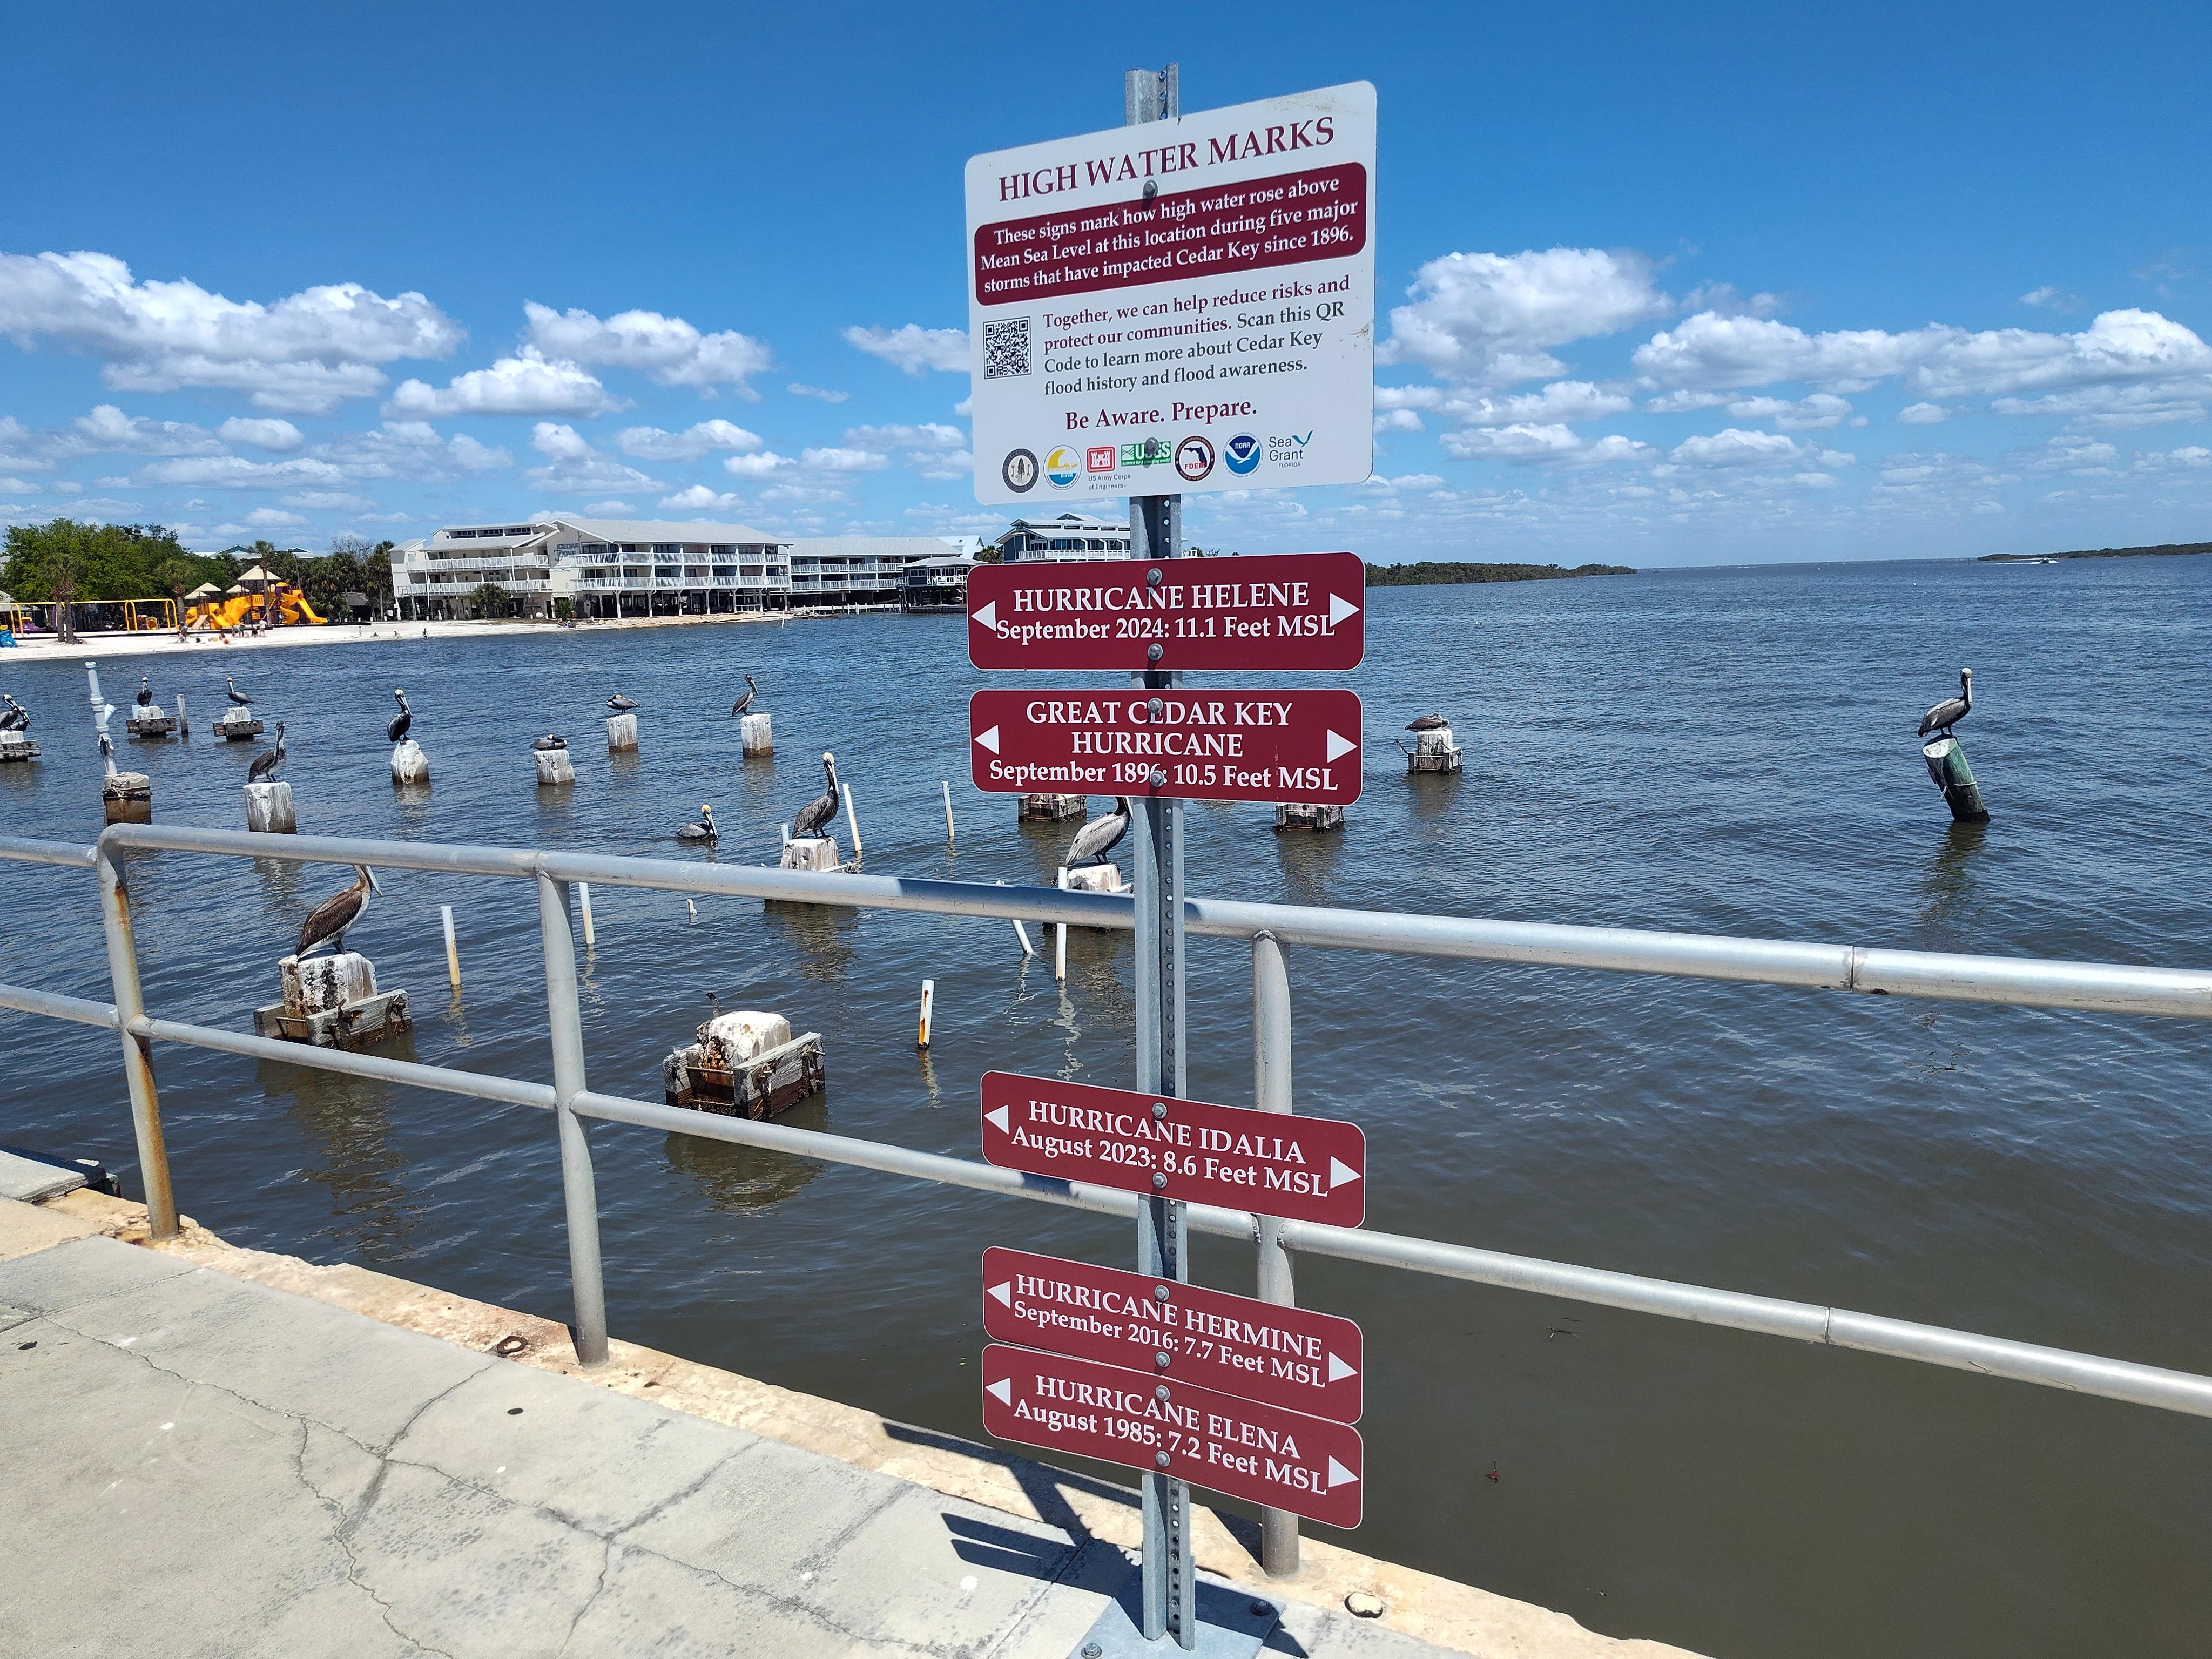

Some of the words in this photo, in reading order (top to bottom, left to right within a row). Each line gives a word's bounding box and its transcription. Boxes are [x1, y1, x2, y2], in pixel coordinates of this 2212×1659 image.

[999, 164, 1077, 201] HIGH
[1085, 143, 1199, 186] WATER
[1208, 117, 1333, 165] MARKS
[994, 228, 1035, 245] These
[1040, 222, 1076, 241] signs
[1081, 212, 1119, 231] mark
[1123, 210, 1156, 225] how
[1161, 199, 1196, 221] high
[1201, 194, 1245, 212] water
[1250, 188, 1283, 204] rose
[1289, 179, 1339, 198] above
[981, 254, 1020, 270] Mean
[1024, 249, 1048, 264] Sea
[1053, 239, 1091, 259] Level
[1096, 238, 1109, 253] at
[1112, 233, 1140, 250] this
[1145, 225, 1206, 246] location
[1211, 217, 1265, 235] during
[1270, 210, 1301, 227] five
[1307, 202, 1358, 222] major
[985, 277, 1030, 292] storms
[1034, 269, 1061, 285] that
[1064, 266, 1098, 281] have
[1103, 251, 1172, 278] impacted
[1177, 246, 1223, 265] Cedar
[1228, 241, 1259, 260] Key
[1265, 236, 1306, 253] since
[1311, 225, 1353, 246] 1896.
[1043, 309, 1112, 330] Together,
[1117, 307, 1138, 319] we
[1143, 304, 1168, 315] can
[1174, 295, 1208, 314] help
[1213, 289, 1266, 307] reduce
[1272, 281, 1312, 299] risks
[1318, 274, 1350, 294] and
[1044, 333, 1094, 355] protect
[1098, 332, 1122, 344] our
[1127, 318, 1231, 341] communities.
[1238, 313, 1274, 328] Scan
[1280, 307, 1310, 323] this
[1316, 301, 1344, 321] QR
[1045, 356, 1081, 372] Code
[1085, 356, 1098, 368] to
[1103, 353, 1139, 366] learn
[1145, 349, 1182, 362] more
[1188, 341, 1232, 358] about
[1237, 334, 1284, 352] Cedar
[1290, 331, 1323, 349] Key
[1046, 378, 1081, 395] flood
[1087, 376, 1137, 392] history
[1142, 369, 1169, 385] and
[1175, 365, 1215, 382] flood
[1220, 360, 1307, 378] awareness.
[1065, 412, 1089, 429] Be
[1096, 409, 1164, 427] Aware.
[1172, 402, 1256, 424] Prepare.
[1135, 442, 1170, 460] UGS
[1269, 436, 1292, 448] Sea
[1270, 449, 1304, 461] Grant
[1184, 462, 1206, 470] FDEM
[1014, 586, 1183, 611] HURRICANE
[1192, 583, 1309, 608] HELENE
[997, 618, 1110, 645] September
[1116, 618, 1169, 638] 2024:
[1175, 617, 1216, 637] 11.1
[1224, 617, 1271, 637] Feet
[1277, 615, 1334, 636] MSL
[1027, 702, 1121, 723] GREAT
[1234, 703, 1292, 725] KEY
[1071, 732, 1243, 757] HURRICANE
[990, 760, 1106, 786] September
[1174, 764, 1216, 785] 10.5
[1223, 766, 1271, 787] Feet
[1278, 767, 1338, 790] MSL
[1029, 1101, 1191, 1147] HURRICANE
[1199, 1128, 1306, 1164] IDALIA
[1011, 1126, 1093, 1158] August
[1099, 1140, 1156, 1169] 2023:
[1164, 1151, 1196, 1175] 8.6
[1204, 1158, 1257, 1186] Feet
[1264, 1167, 1328, 1197] MSL
[1016, 1274, 1177, 1326] HURRICANE
[1185, 1309, 1321, 1360] HERMINE
[1015, 1301, 1122, 1338] September
[1128, 1324, 1178, 1351] 2016:
[1185, 1337, 1213, 1359] 7.7
[1219, 1345, 1264, 1373] Feet
[1271, 1357, 1325, 1387] MSL
[1036, 1375, 1199, 1431] HURRICANE
[1208, 1414, 1300, 1459] ELENA
[1014, 1399, 1097, 1433] August
[1104, 1417, 1161, 1447] 1985:
[1169, 1431, 1201, 1459] 7.2
[1208, 1442, 1258, 1475] Feet
[1265, 1458, 1326, 1495] MSL
